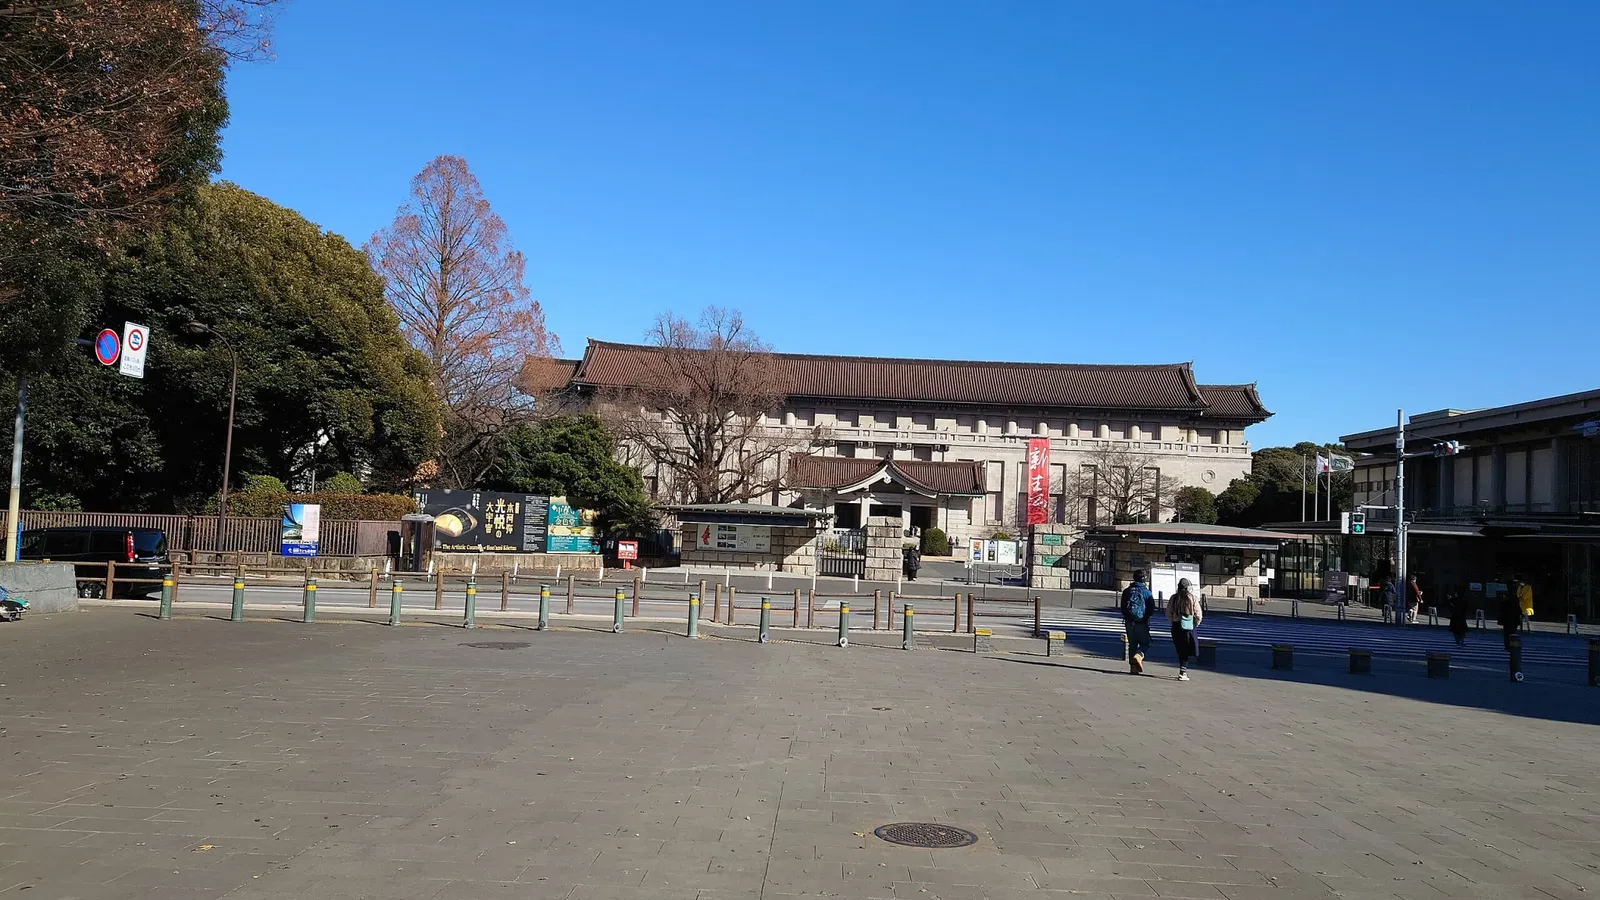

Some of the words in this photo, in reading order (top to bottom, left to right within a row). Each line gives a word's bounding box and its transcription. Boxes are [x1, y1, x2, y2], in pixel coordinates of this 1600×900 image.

[485, 501, 494, 534] 大宇宙
[494, 498, 506, 538] 光悦の
